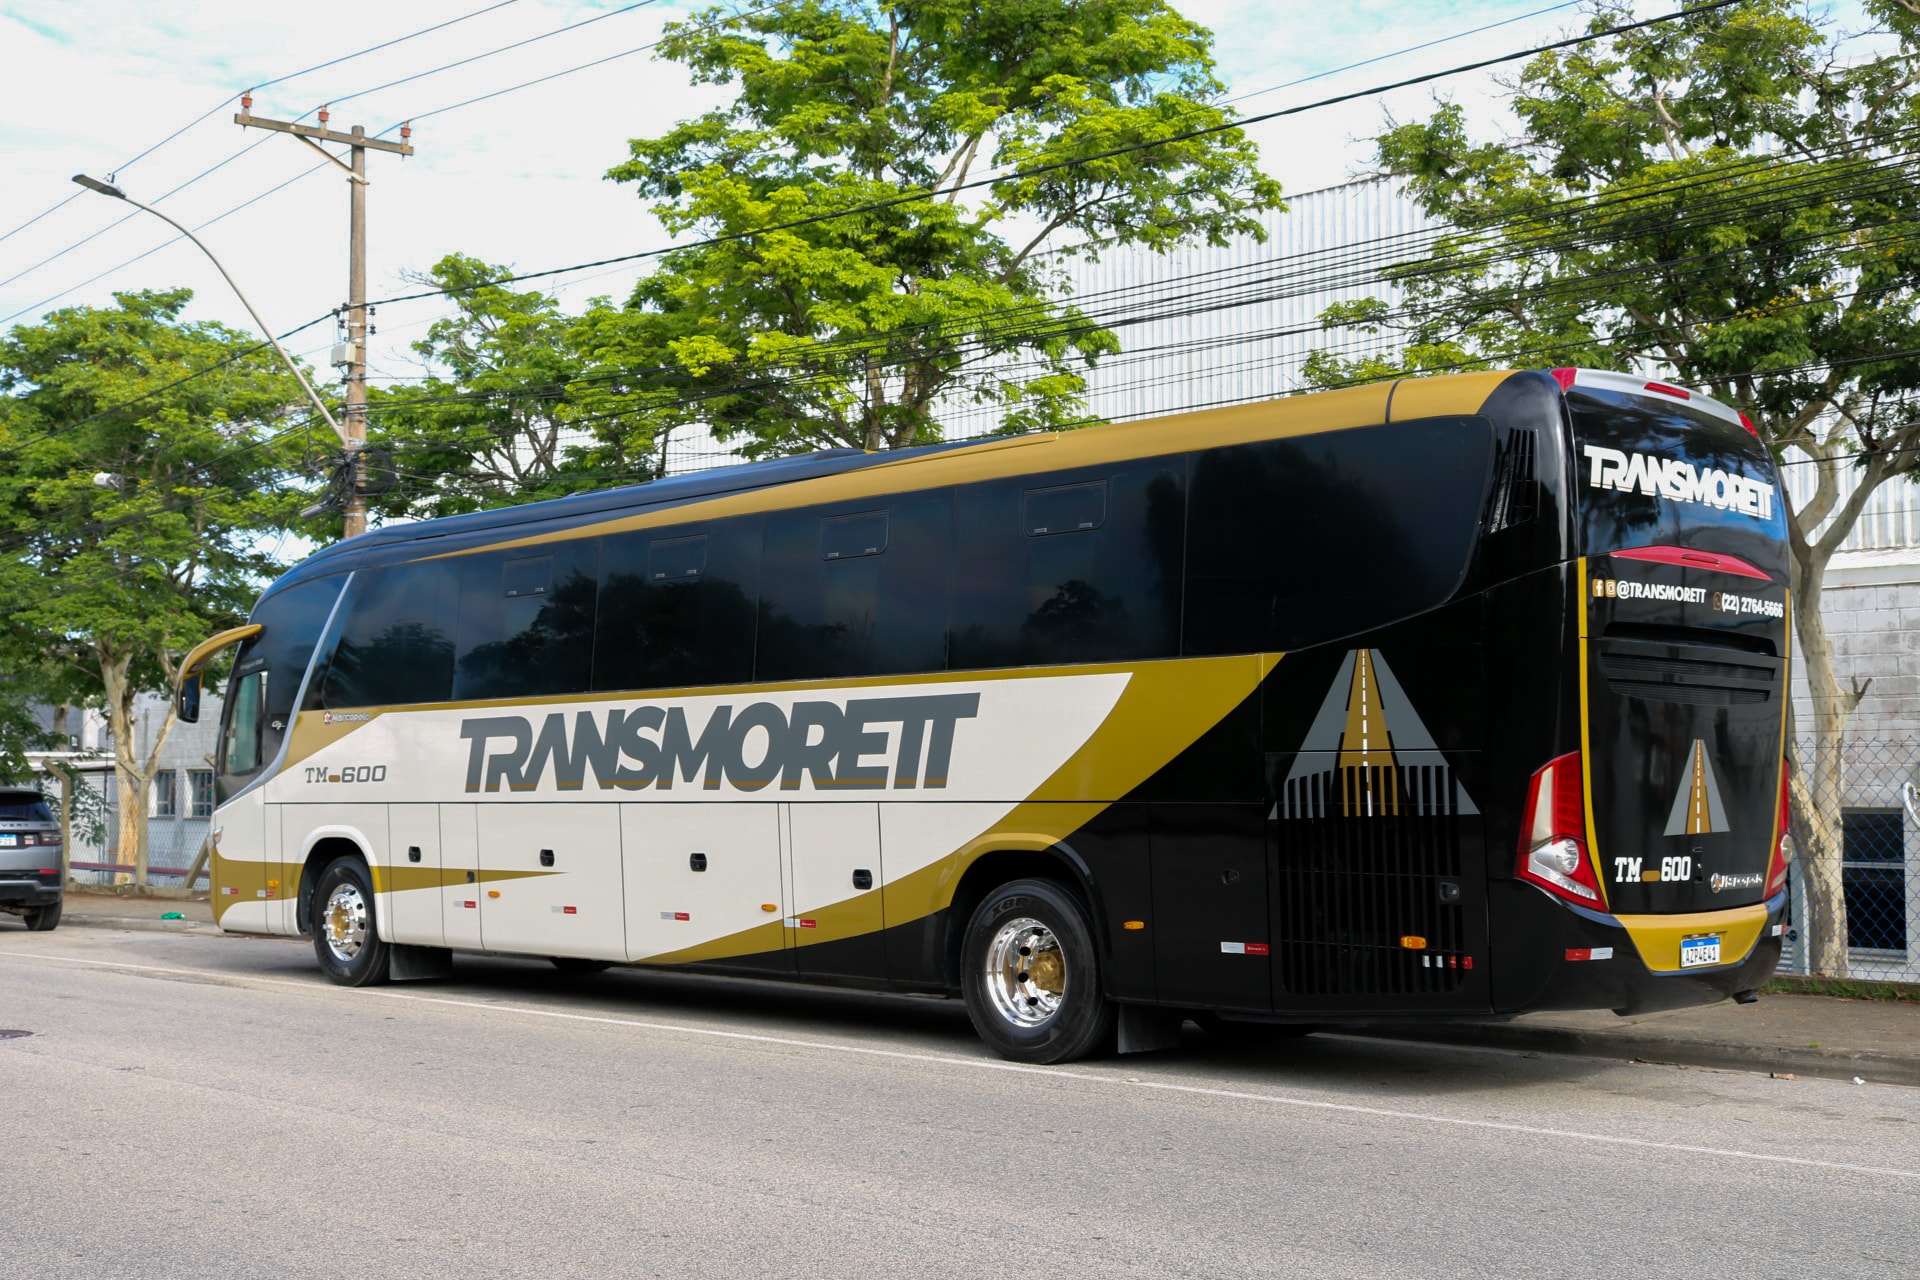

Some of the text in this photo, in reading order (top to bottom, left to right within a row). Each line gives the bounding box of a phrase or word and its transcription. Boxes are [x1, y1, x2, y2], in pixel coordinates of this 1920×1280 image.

[1584, 445, 1774, 520] TRANSMORETT
[1616, 580, 1706, 604] @TRANSMORETT
[1721, 593, 1740, 614] (22)
[1740, 597, 1784, 618] 2764-5666
[459, 692, 981, 793] TRANSMORETT
